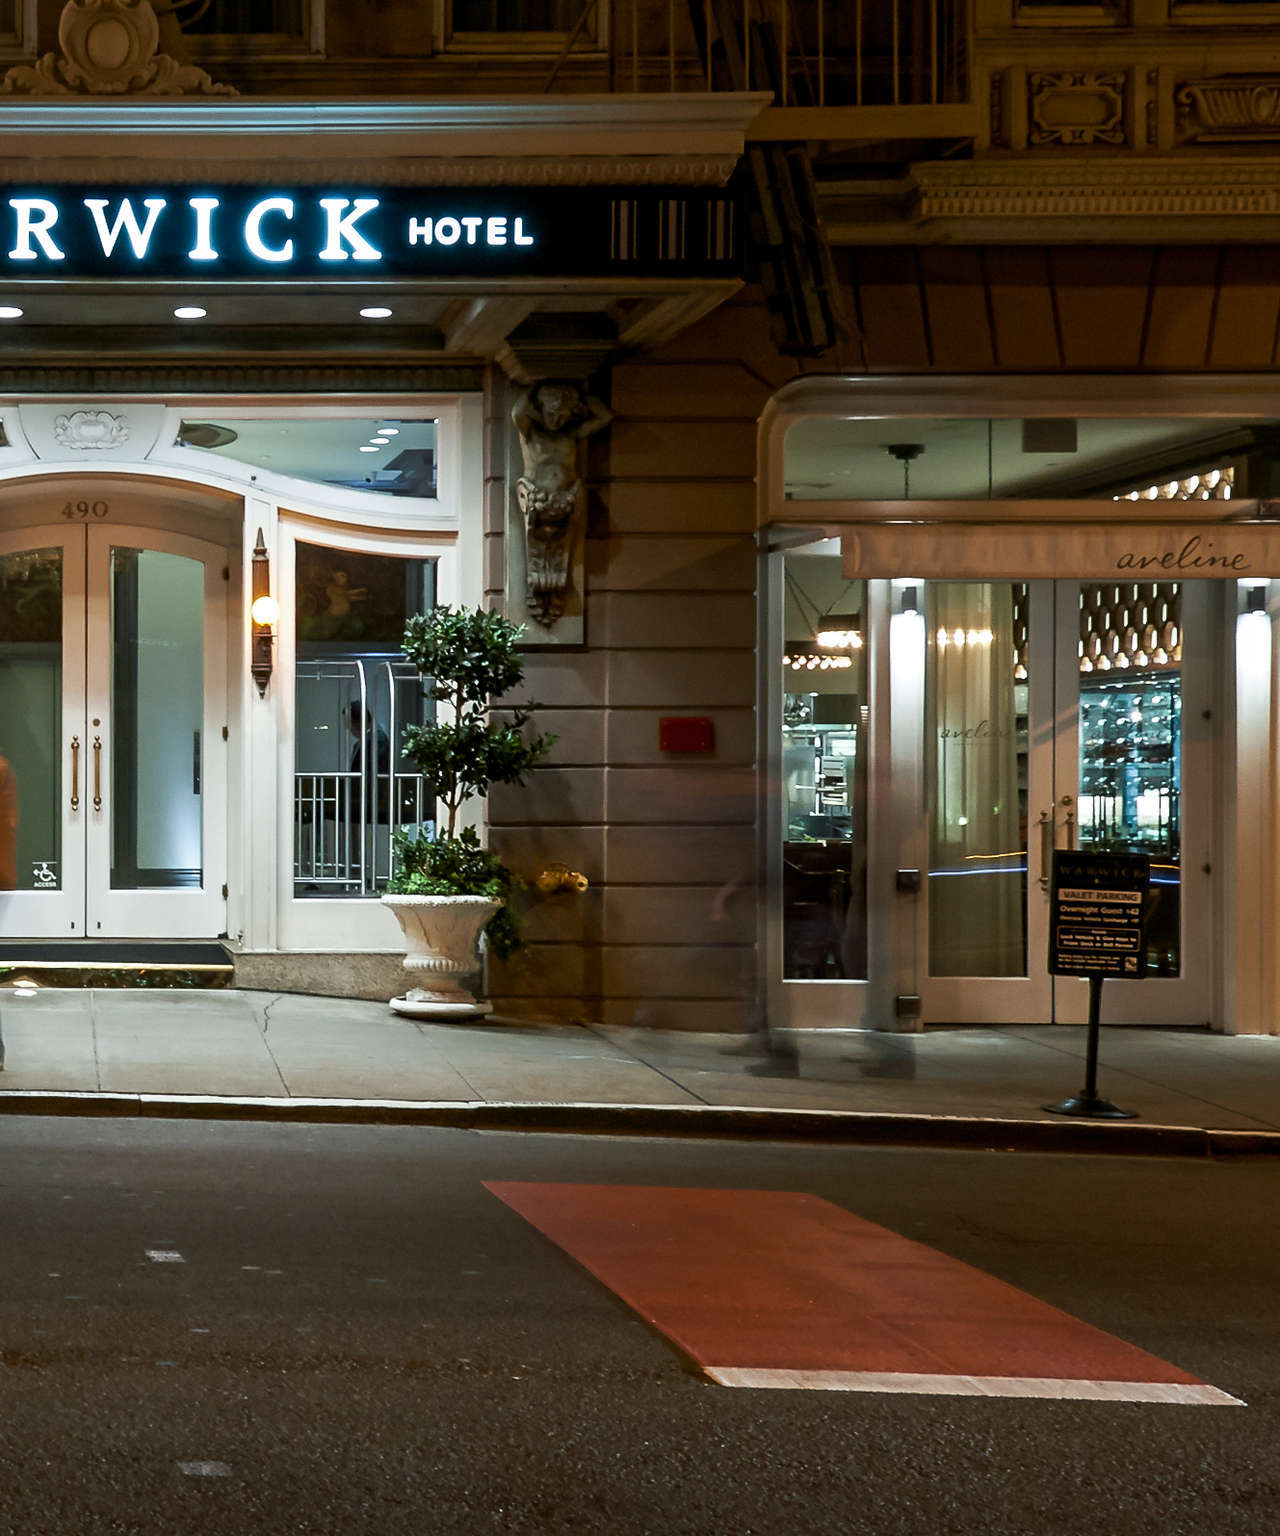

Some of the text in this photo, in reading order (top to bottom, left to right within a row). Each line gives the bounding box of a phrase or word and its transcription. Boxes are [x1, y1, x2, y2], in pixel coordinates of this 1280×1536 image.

[408, 216, 534, 246] HOTEL
[61, 501, 109, 519] 490
[1116, 535, 1252, 571] aveline
[1063, 891, 1138, 902] VALET PARKING
